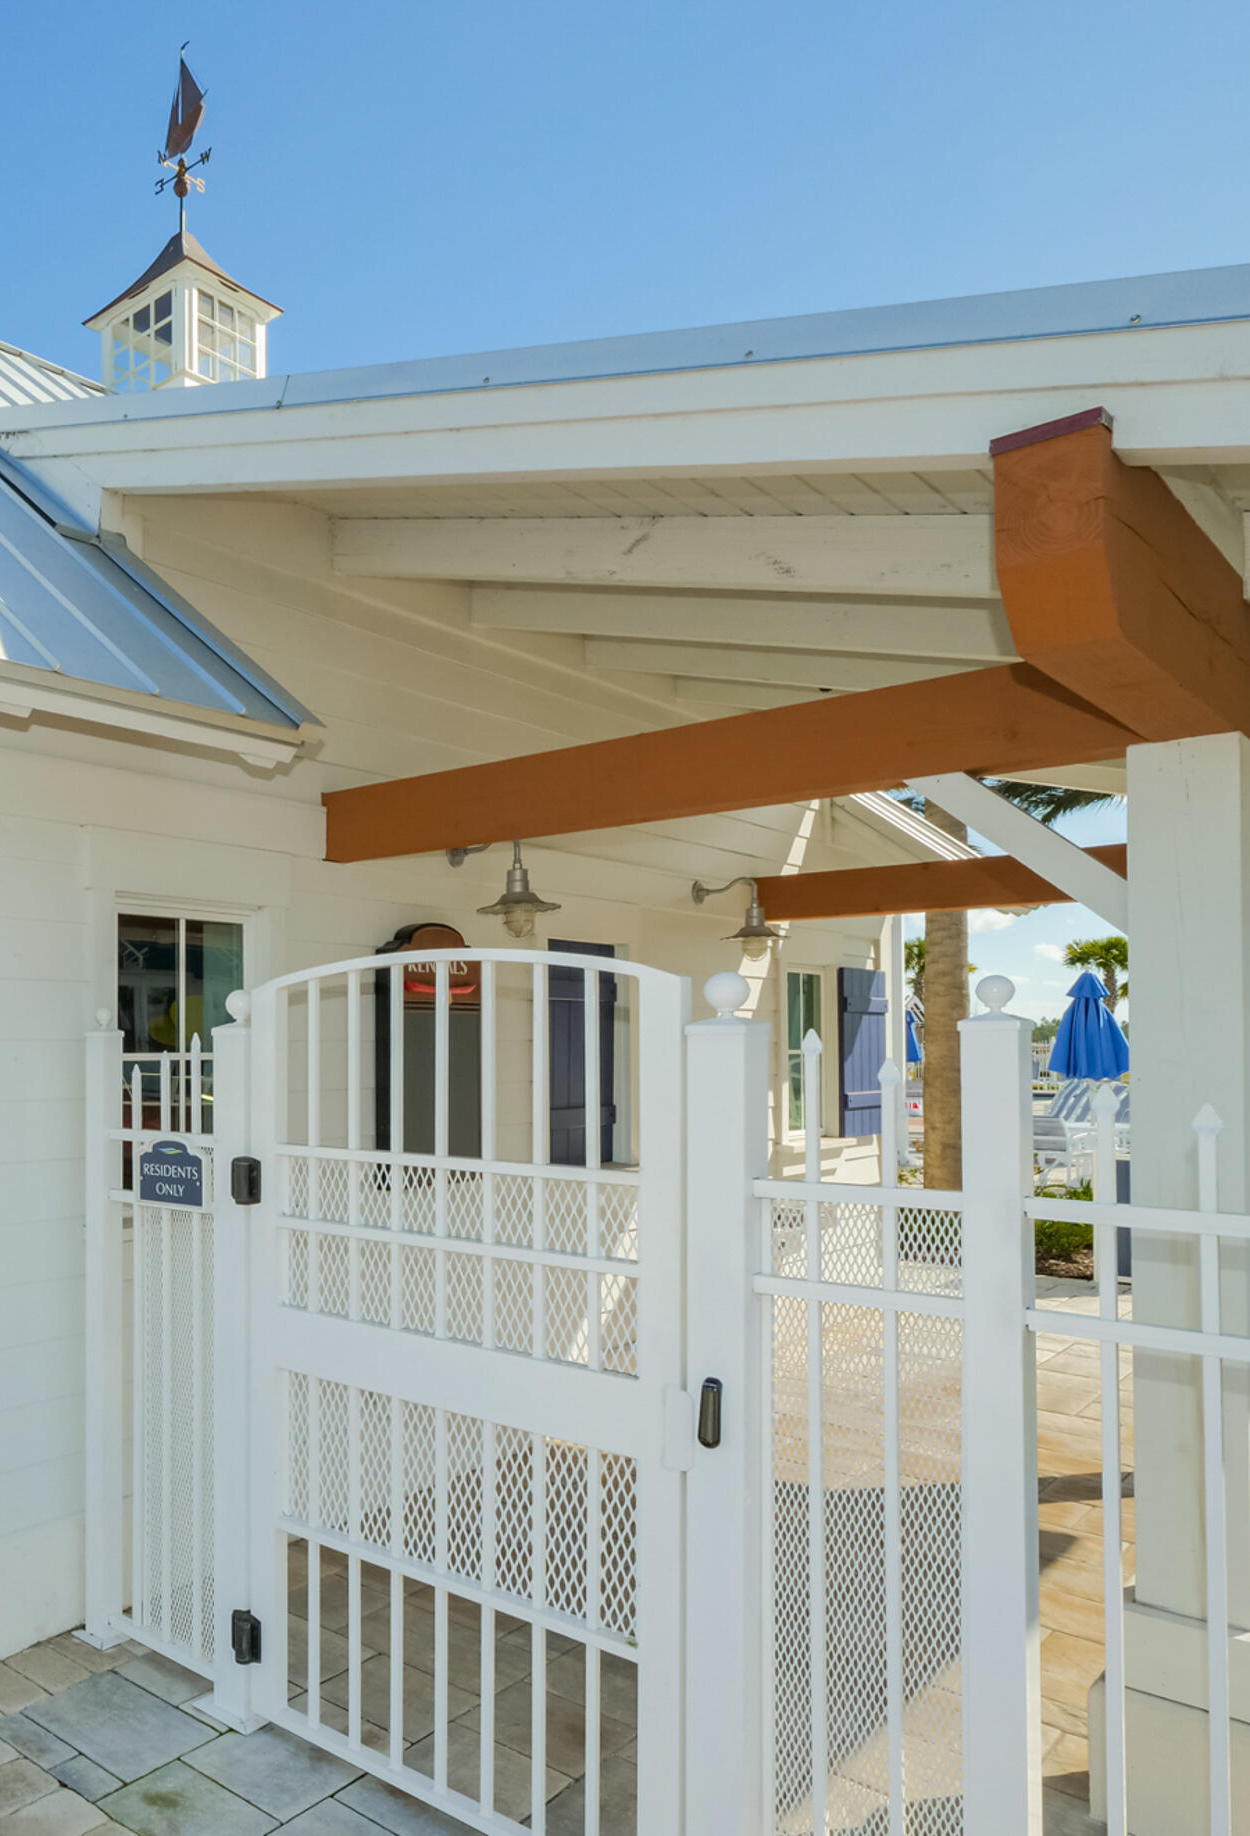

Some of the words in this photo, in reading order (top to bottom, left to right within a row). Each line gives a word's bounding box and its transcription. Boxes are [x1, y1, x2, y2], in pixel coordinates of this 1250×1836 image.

[408, 961, 468, 976] RENLS
[143, 1163, 199, 1180] RESIDENTS
[155, 1181, 185, 1197] ONLY
